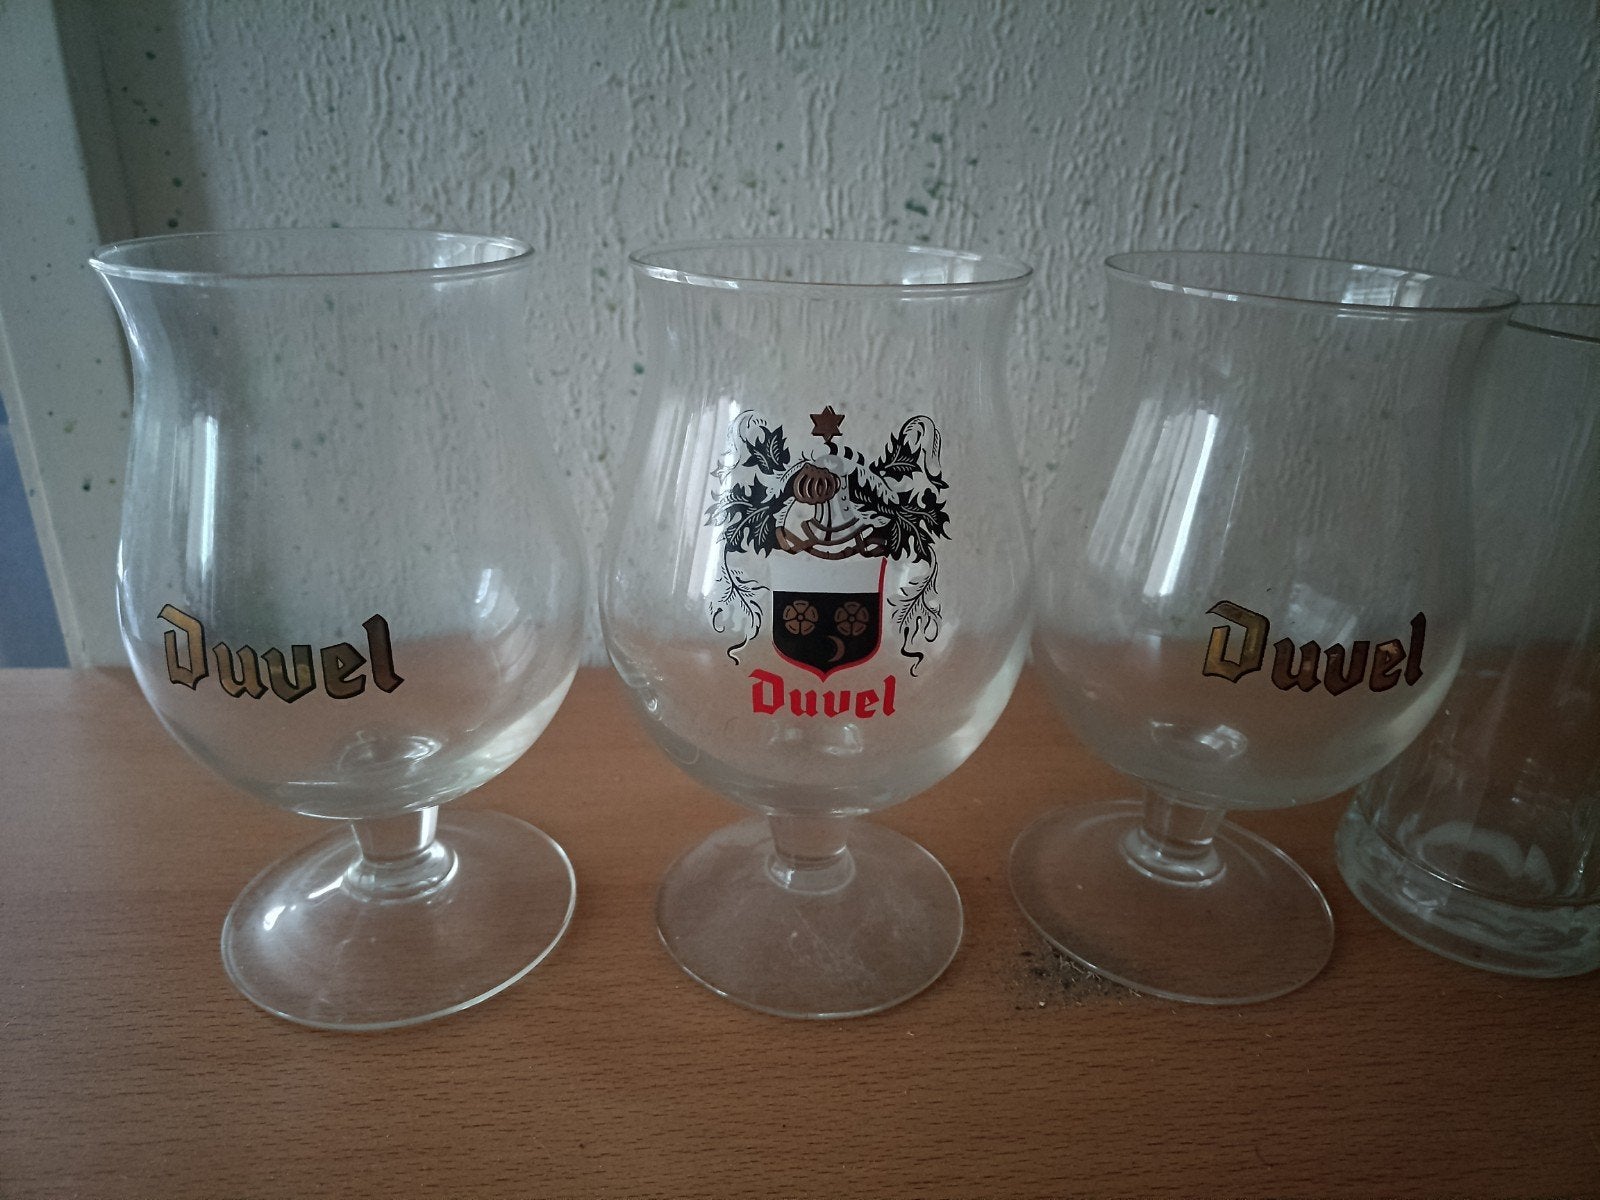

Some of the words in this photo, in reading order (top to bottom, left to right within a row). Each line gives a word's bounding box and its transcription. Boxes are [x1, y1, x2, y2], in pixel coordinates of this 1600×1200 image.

[157, 603, 404, 703] Duvel
[748, 669, 896, 718] Duvel
[1205, 600, 1427, 696] Duvel
